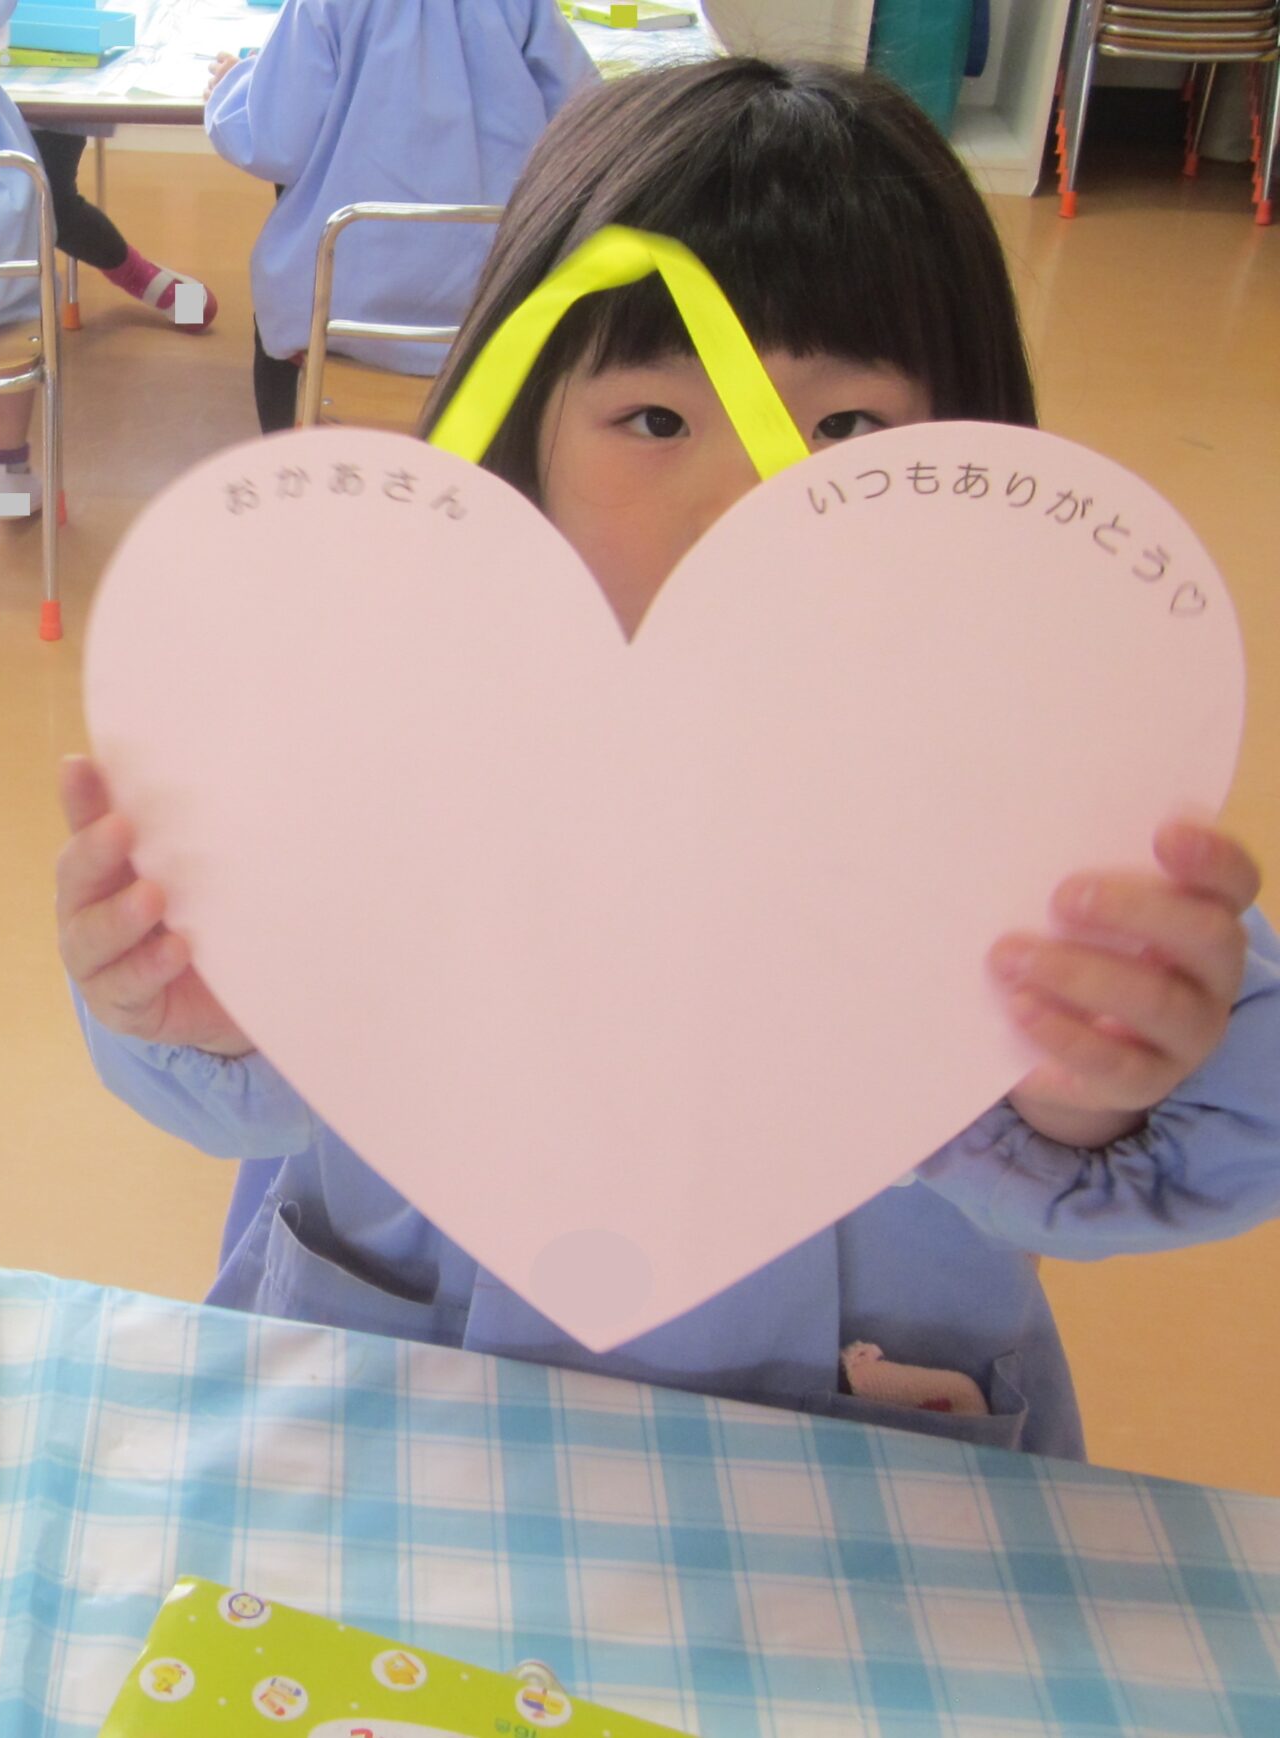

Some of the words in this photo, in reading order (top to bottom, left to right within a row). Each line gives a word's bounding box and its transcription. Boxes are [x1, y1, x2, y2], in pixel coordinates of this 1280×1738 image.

[224, 462, 468, 521] おかあさん
[807, 462, 1171, 583] いつもありがとう
